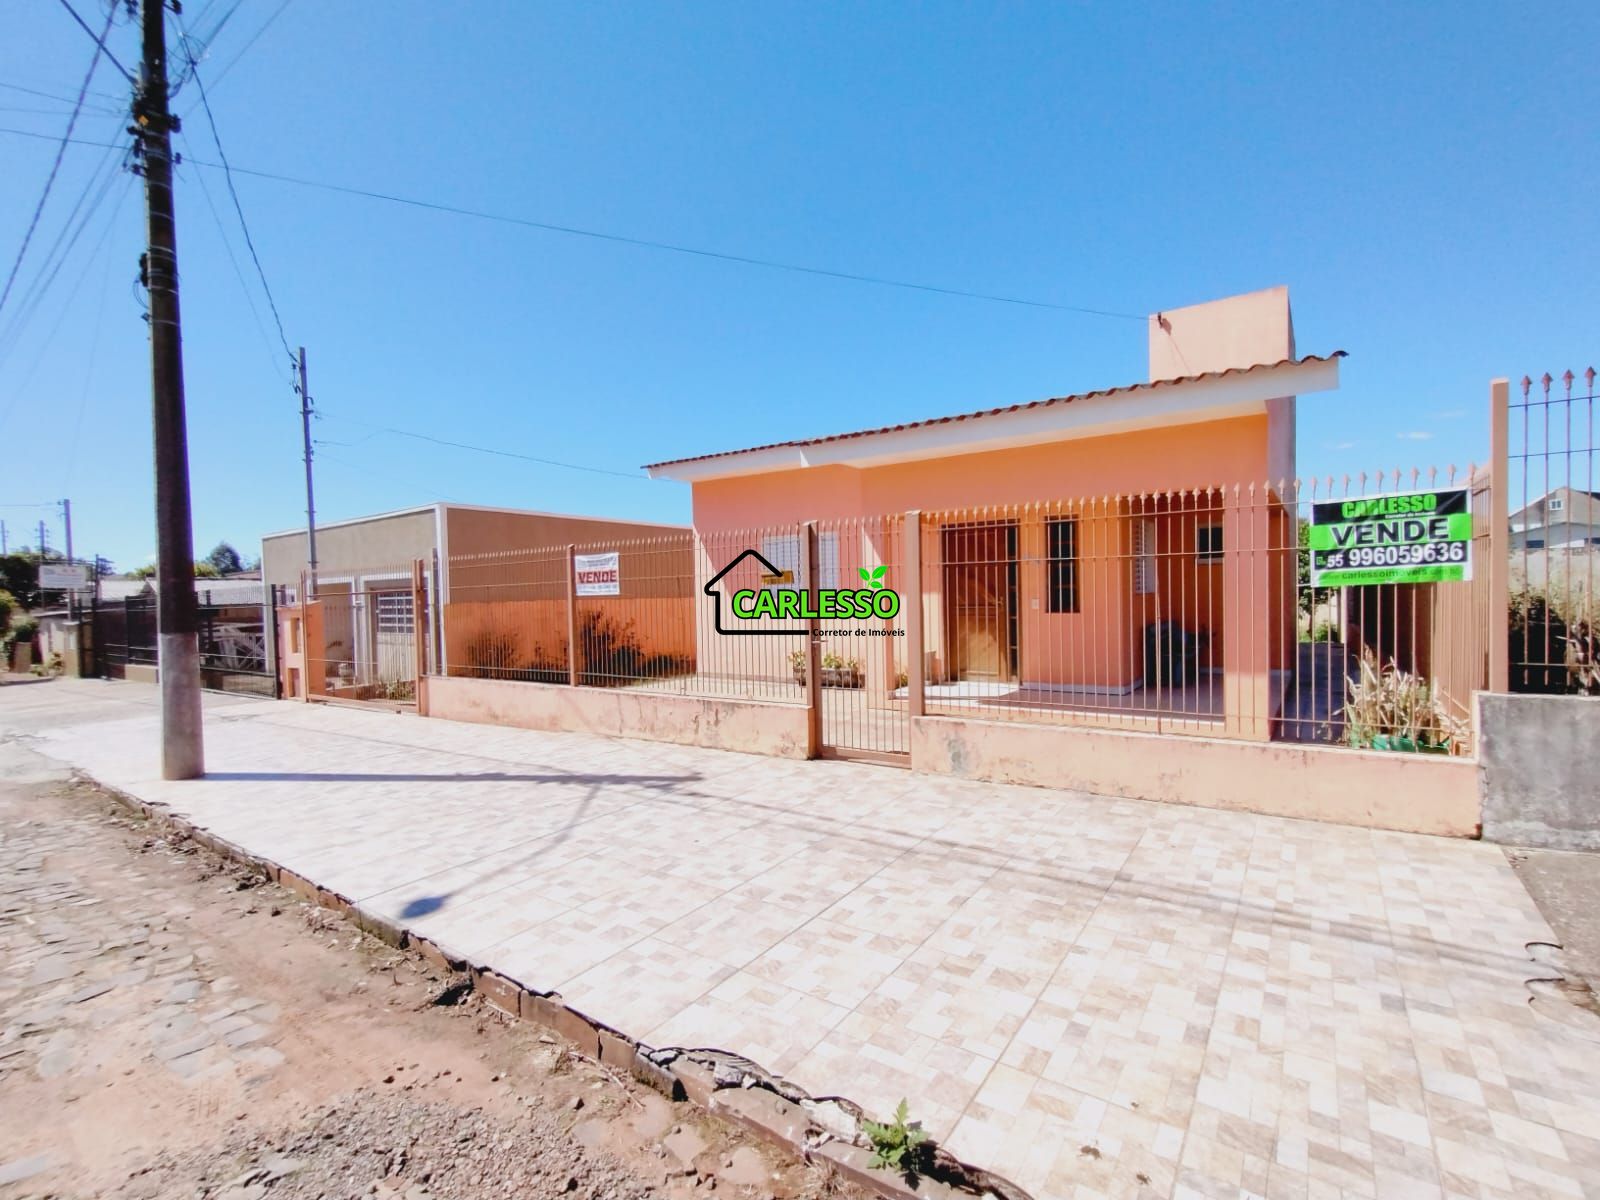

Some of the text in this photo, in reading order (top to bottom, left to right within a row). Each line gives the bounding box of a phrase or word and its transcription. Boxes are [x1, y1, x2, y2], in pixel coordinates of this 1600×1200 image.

[1341, 493, 1437, 519] CARLESSO
[1331, 518, 1449, 547] VENDE
[1327, 542, 1463, 568] 55 996059636
[577, 569, 617, 584] VENDE
